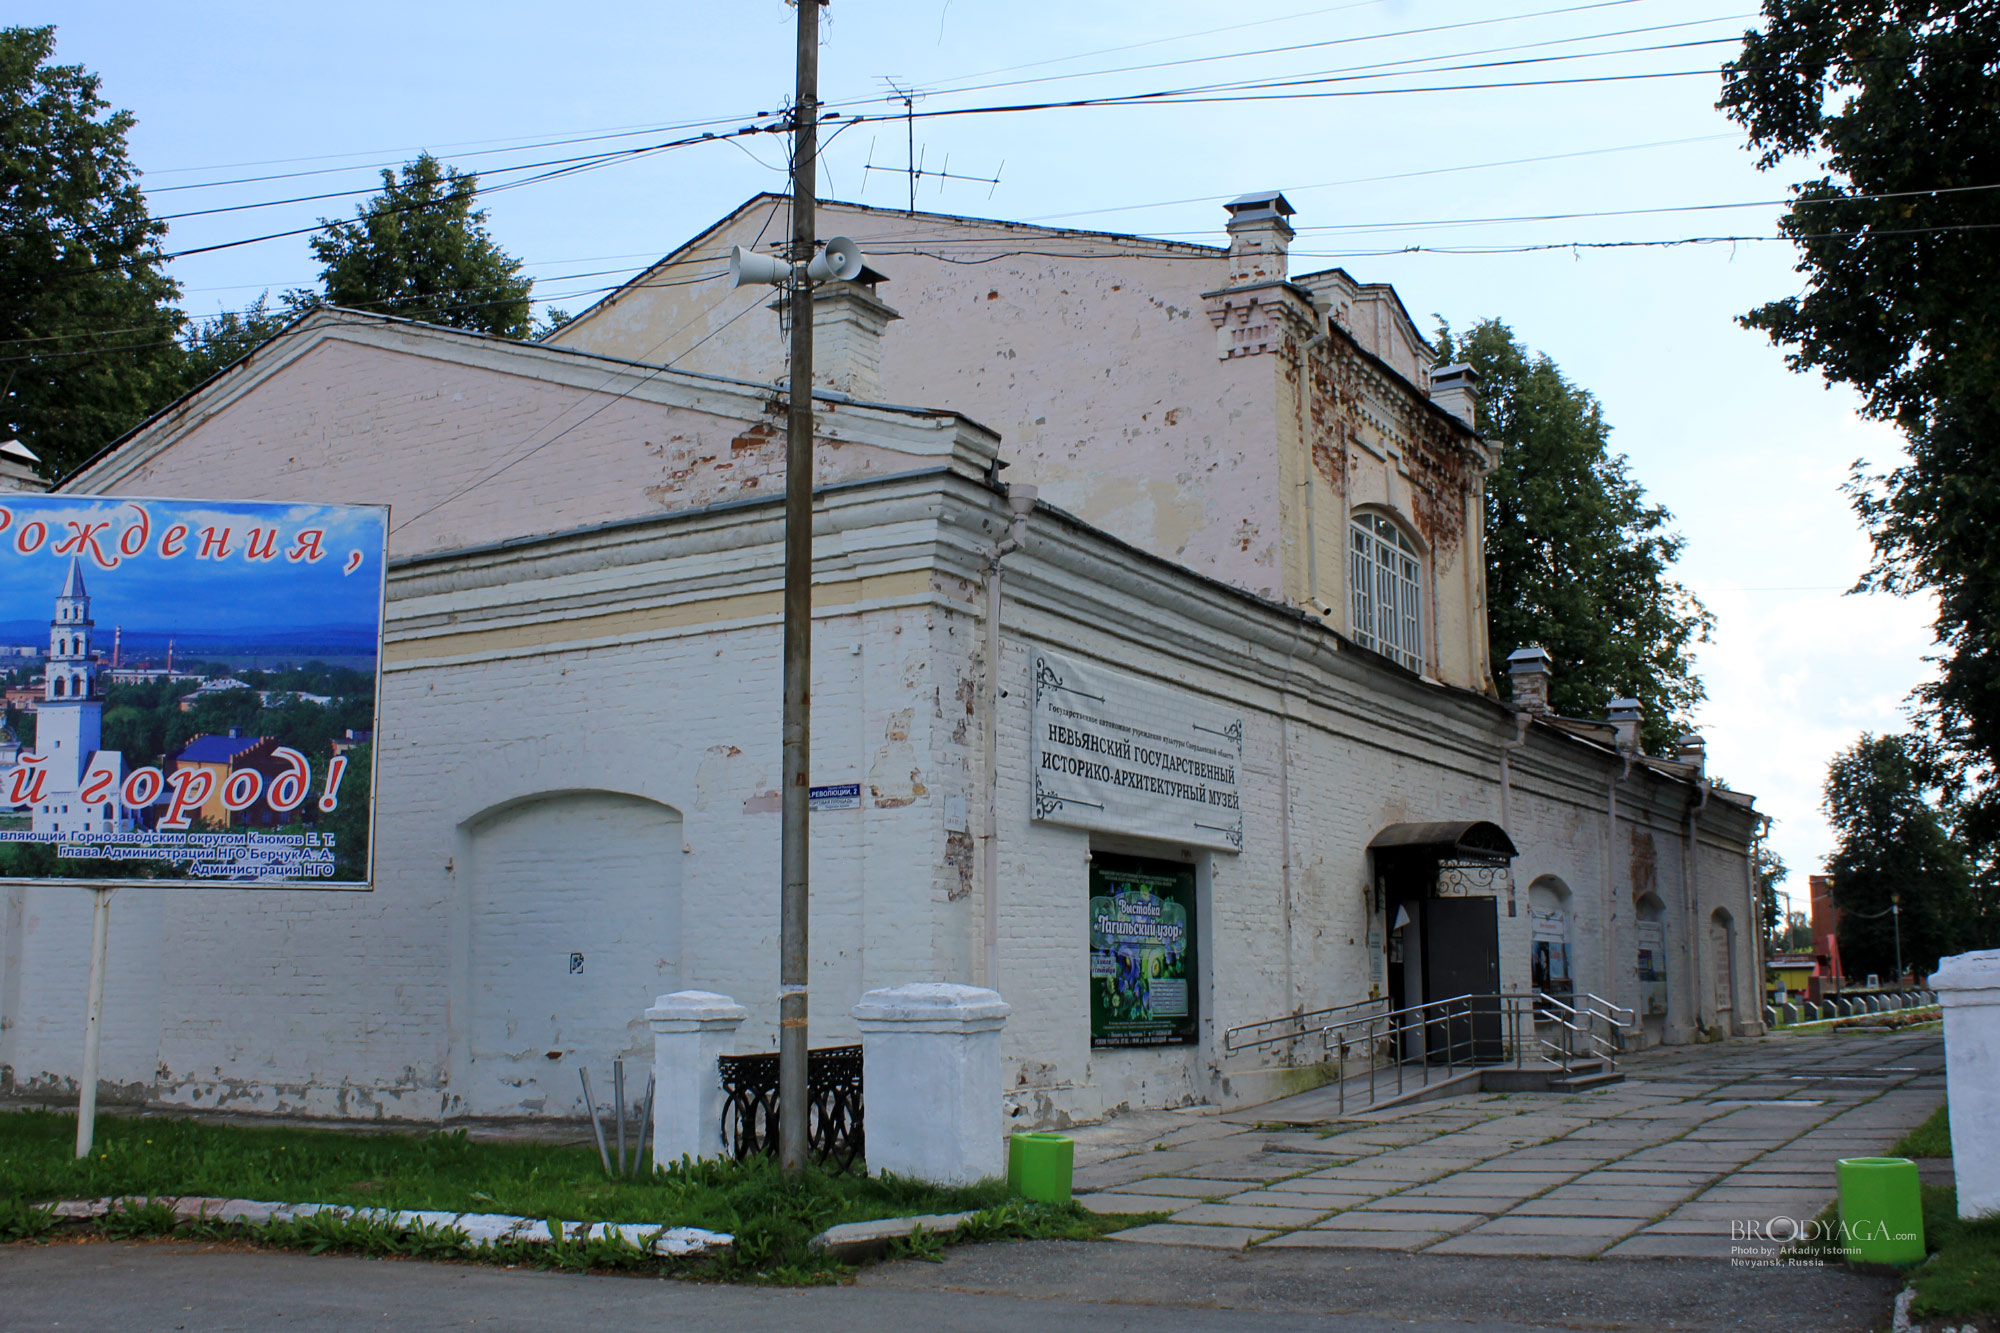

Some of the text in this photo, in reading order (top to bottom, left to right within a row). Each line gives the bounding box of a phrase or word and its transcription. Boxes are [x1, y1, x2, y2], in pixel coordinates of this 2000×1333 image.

[1048, 723, 1235, 785] НЕВЬЯНСКИЙ ГОСУДАРСТВЕННЫЙ
[80, 749, 345, 825] город!
[1041, 751, 1240, 810] ИСТОРИКО-АРХИТЕКТУРНЫЙ МУЗЕЙ
[70, 830, 185, 845] Горнозаводским
[188, 833, 245, 846] округом
[247, 832, 304, 845] Каюмов
[306, 833, 320, 846] Е.
[323, 833, 336, 846] Т.
[58, 845, 335, 862] Глава Администрации НГО Берчук А. А.
[190, 862, 335, 877] Администрация НГО
[1118, 898, 1161, 916] Выставка
[1093, 914, 1183, 941] «Тагильский узор»
